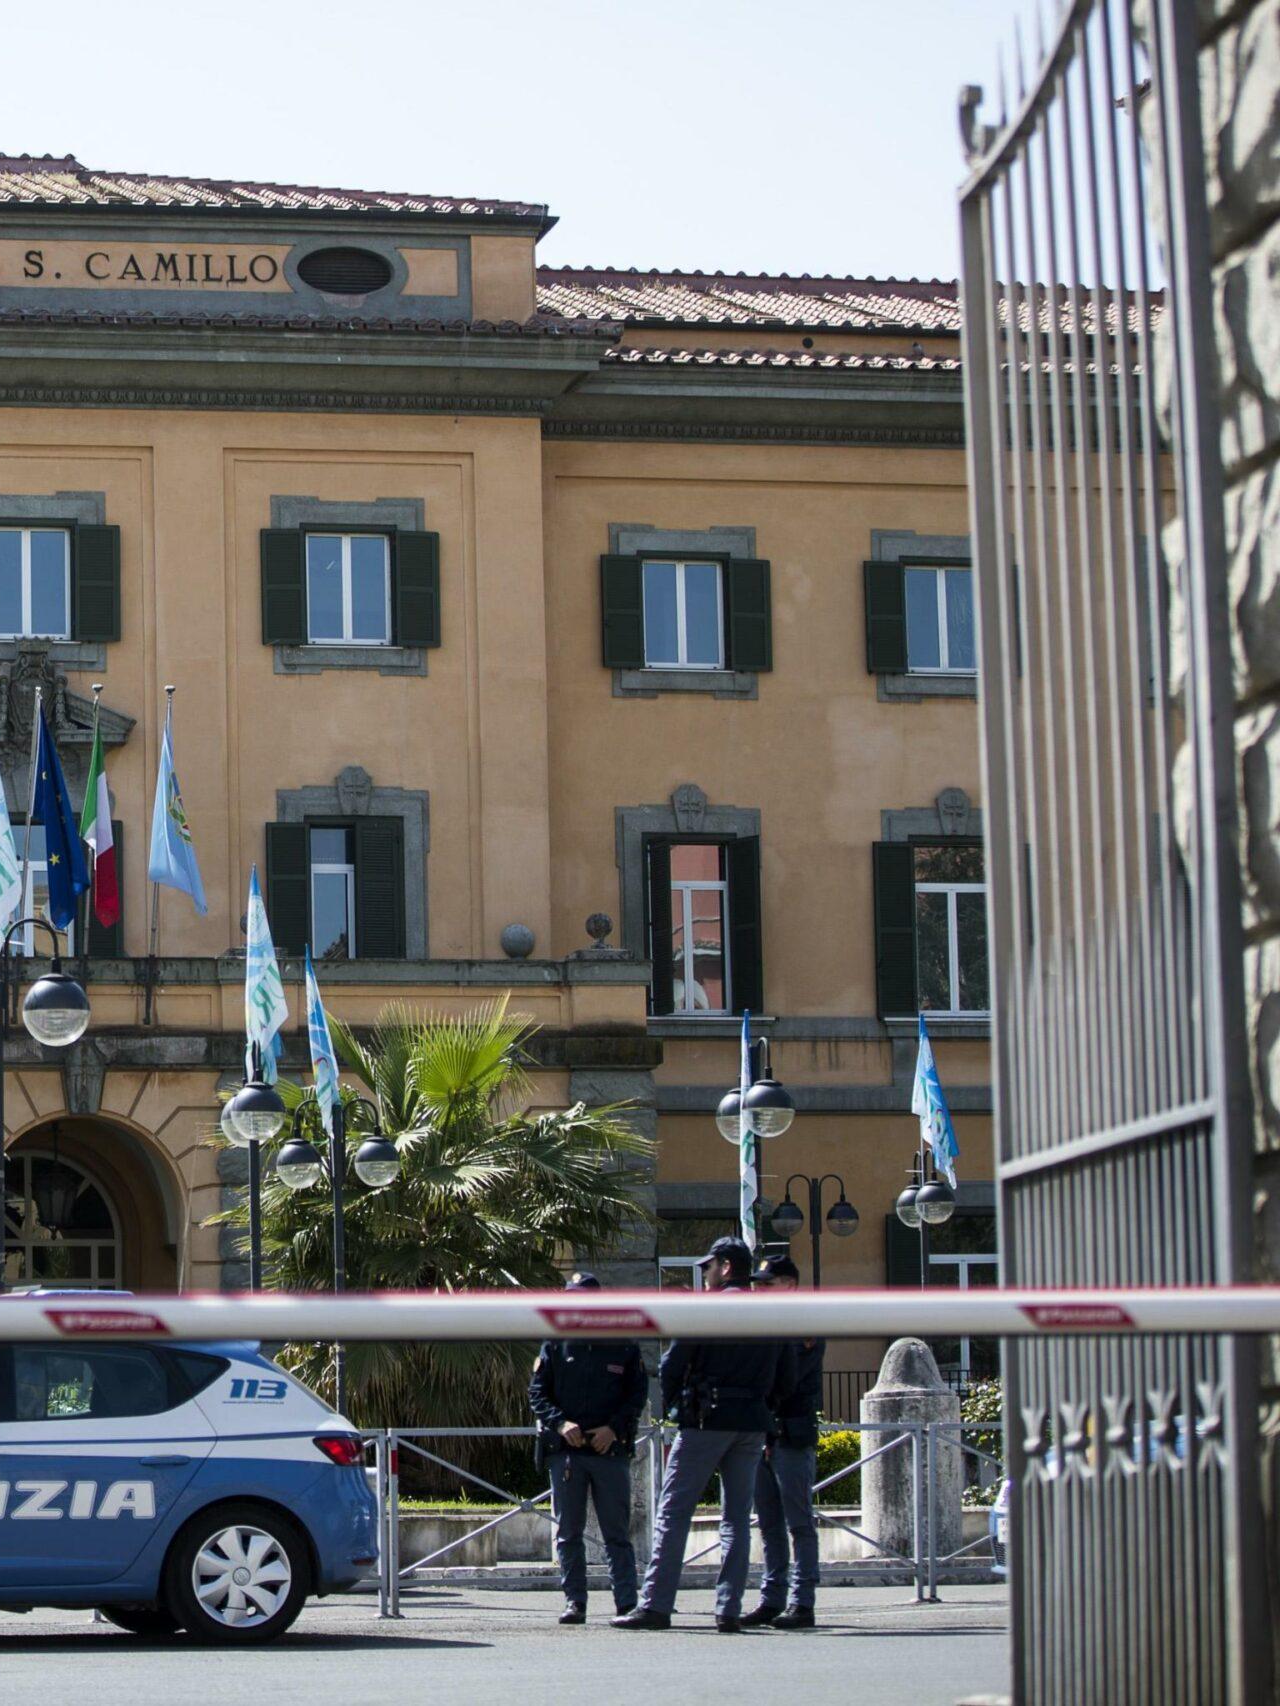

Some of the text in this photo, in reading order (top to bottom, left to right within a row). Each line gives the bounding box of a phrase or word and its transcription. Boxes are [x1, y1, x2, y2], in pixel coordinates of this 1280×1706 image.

[23, 250, 62, 278] S.
[85, 252, 278, 284] CAMILLO
[230, 1379, 288, 1400] 113
